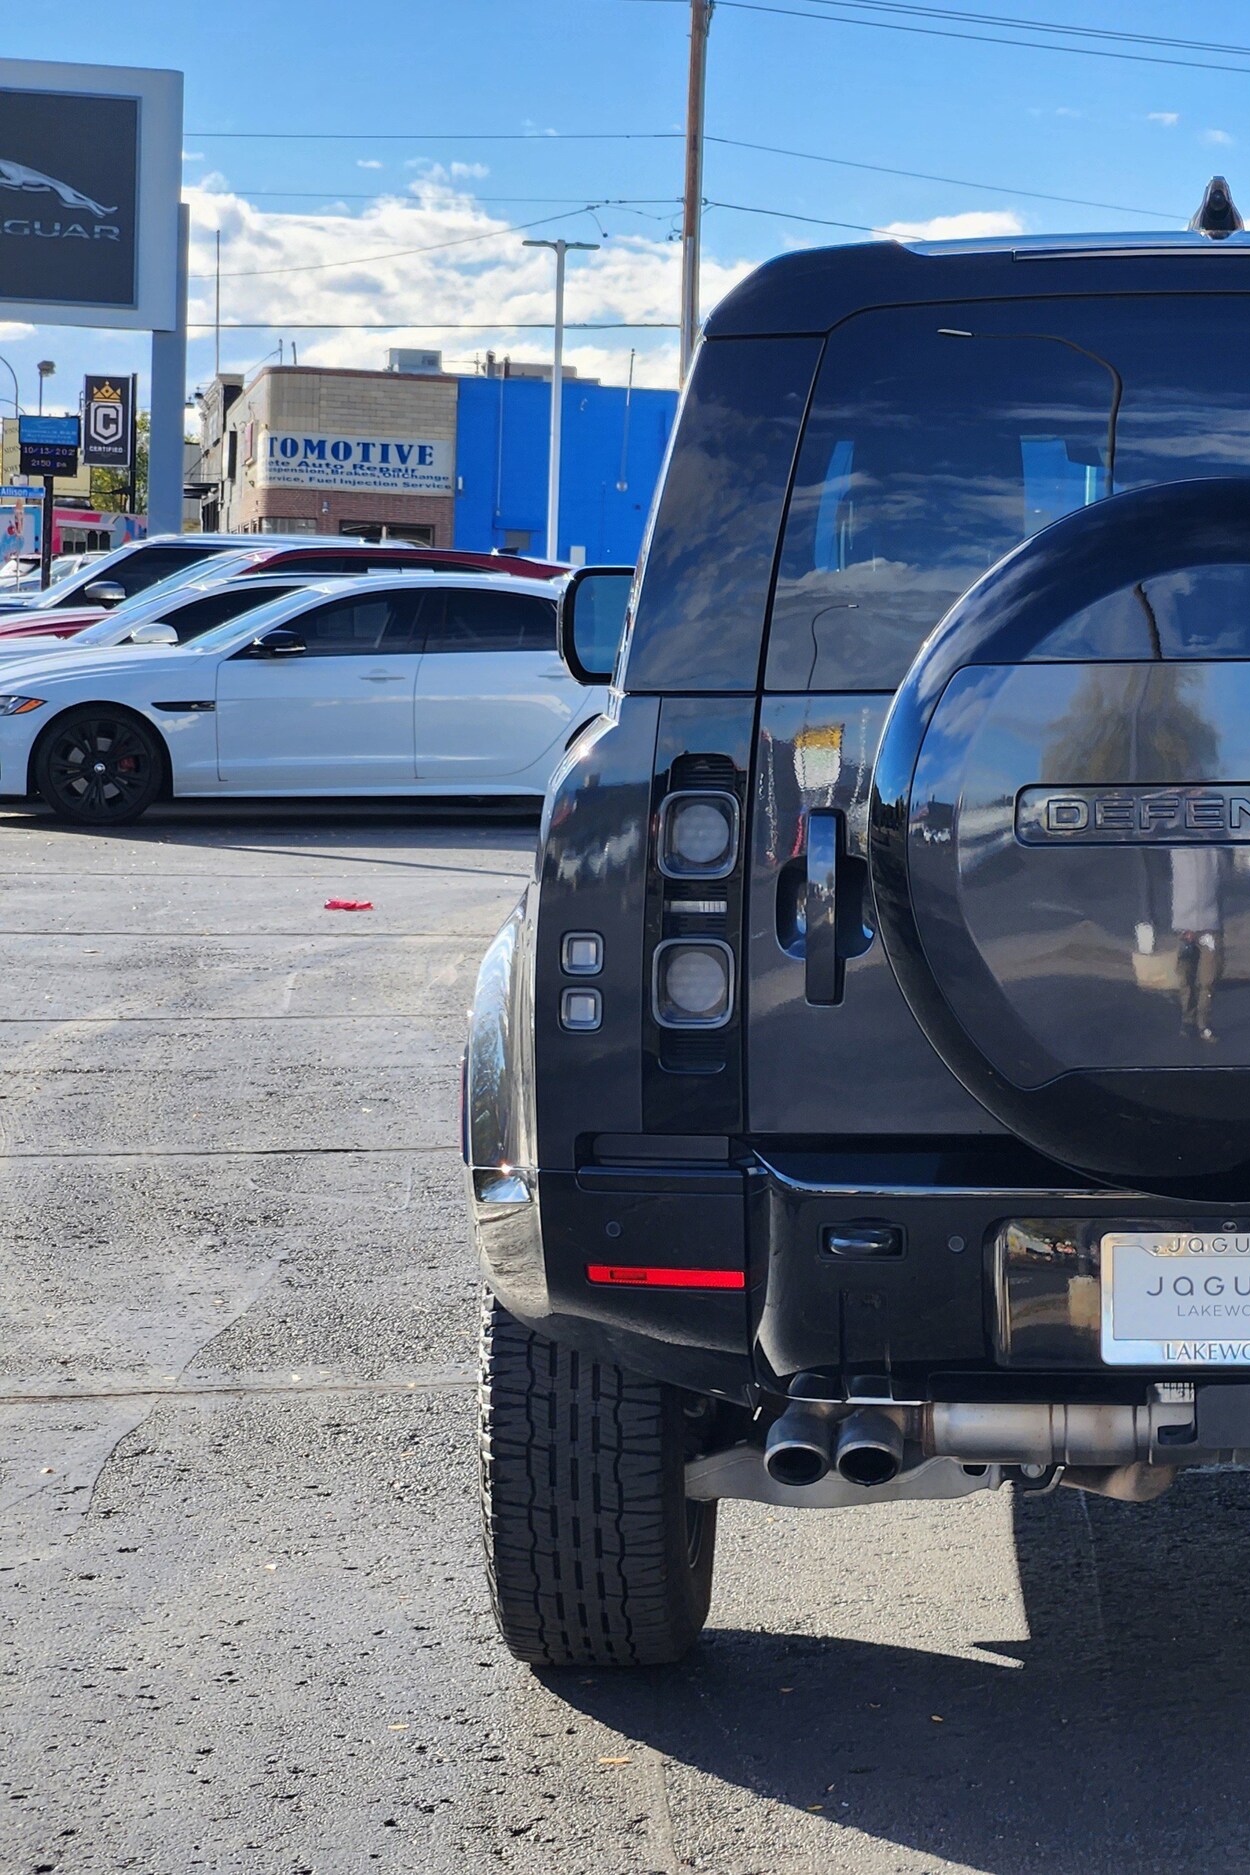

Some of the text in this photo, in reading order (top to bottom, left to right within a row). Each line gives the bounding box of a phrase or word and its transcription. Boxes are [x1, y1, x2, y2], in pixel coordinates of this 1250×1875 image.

[0, 220, 120, 241] GUAR
[297, 460, 345, 470] Auto
[352, 463, 419, 474] Repair
[309, 476, 337, 484] Fuel
[340, 478, 398, 487] Injection
[402, 481, 452, 490] Service
[1, 487, 28, 496] Allison
